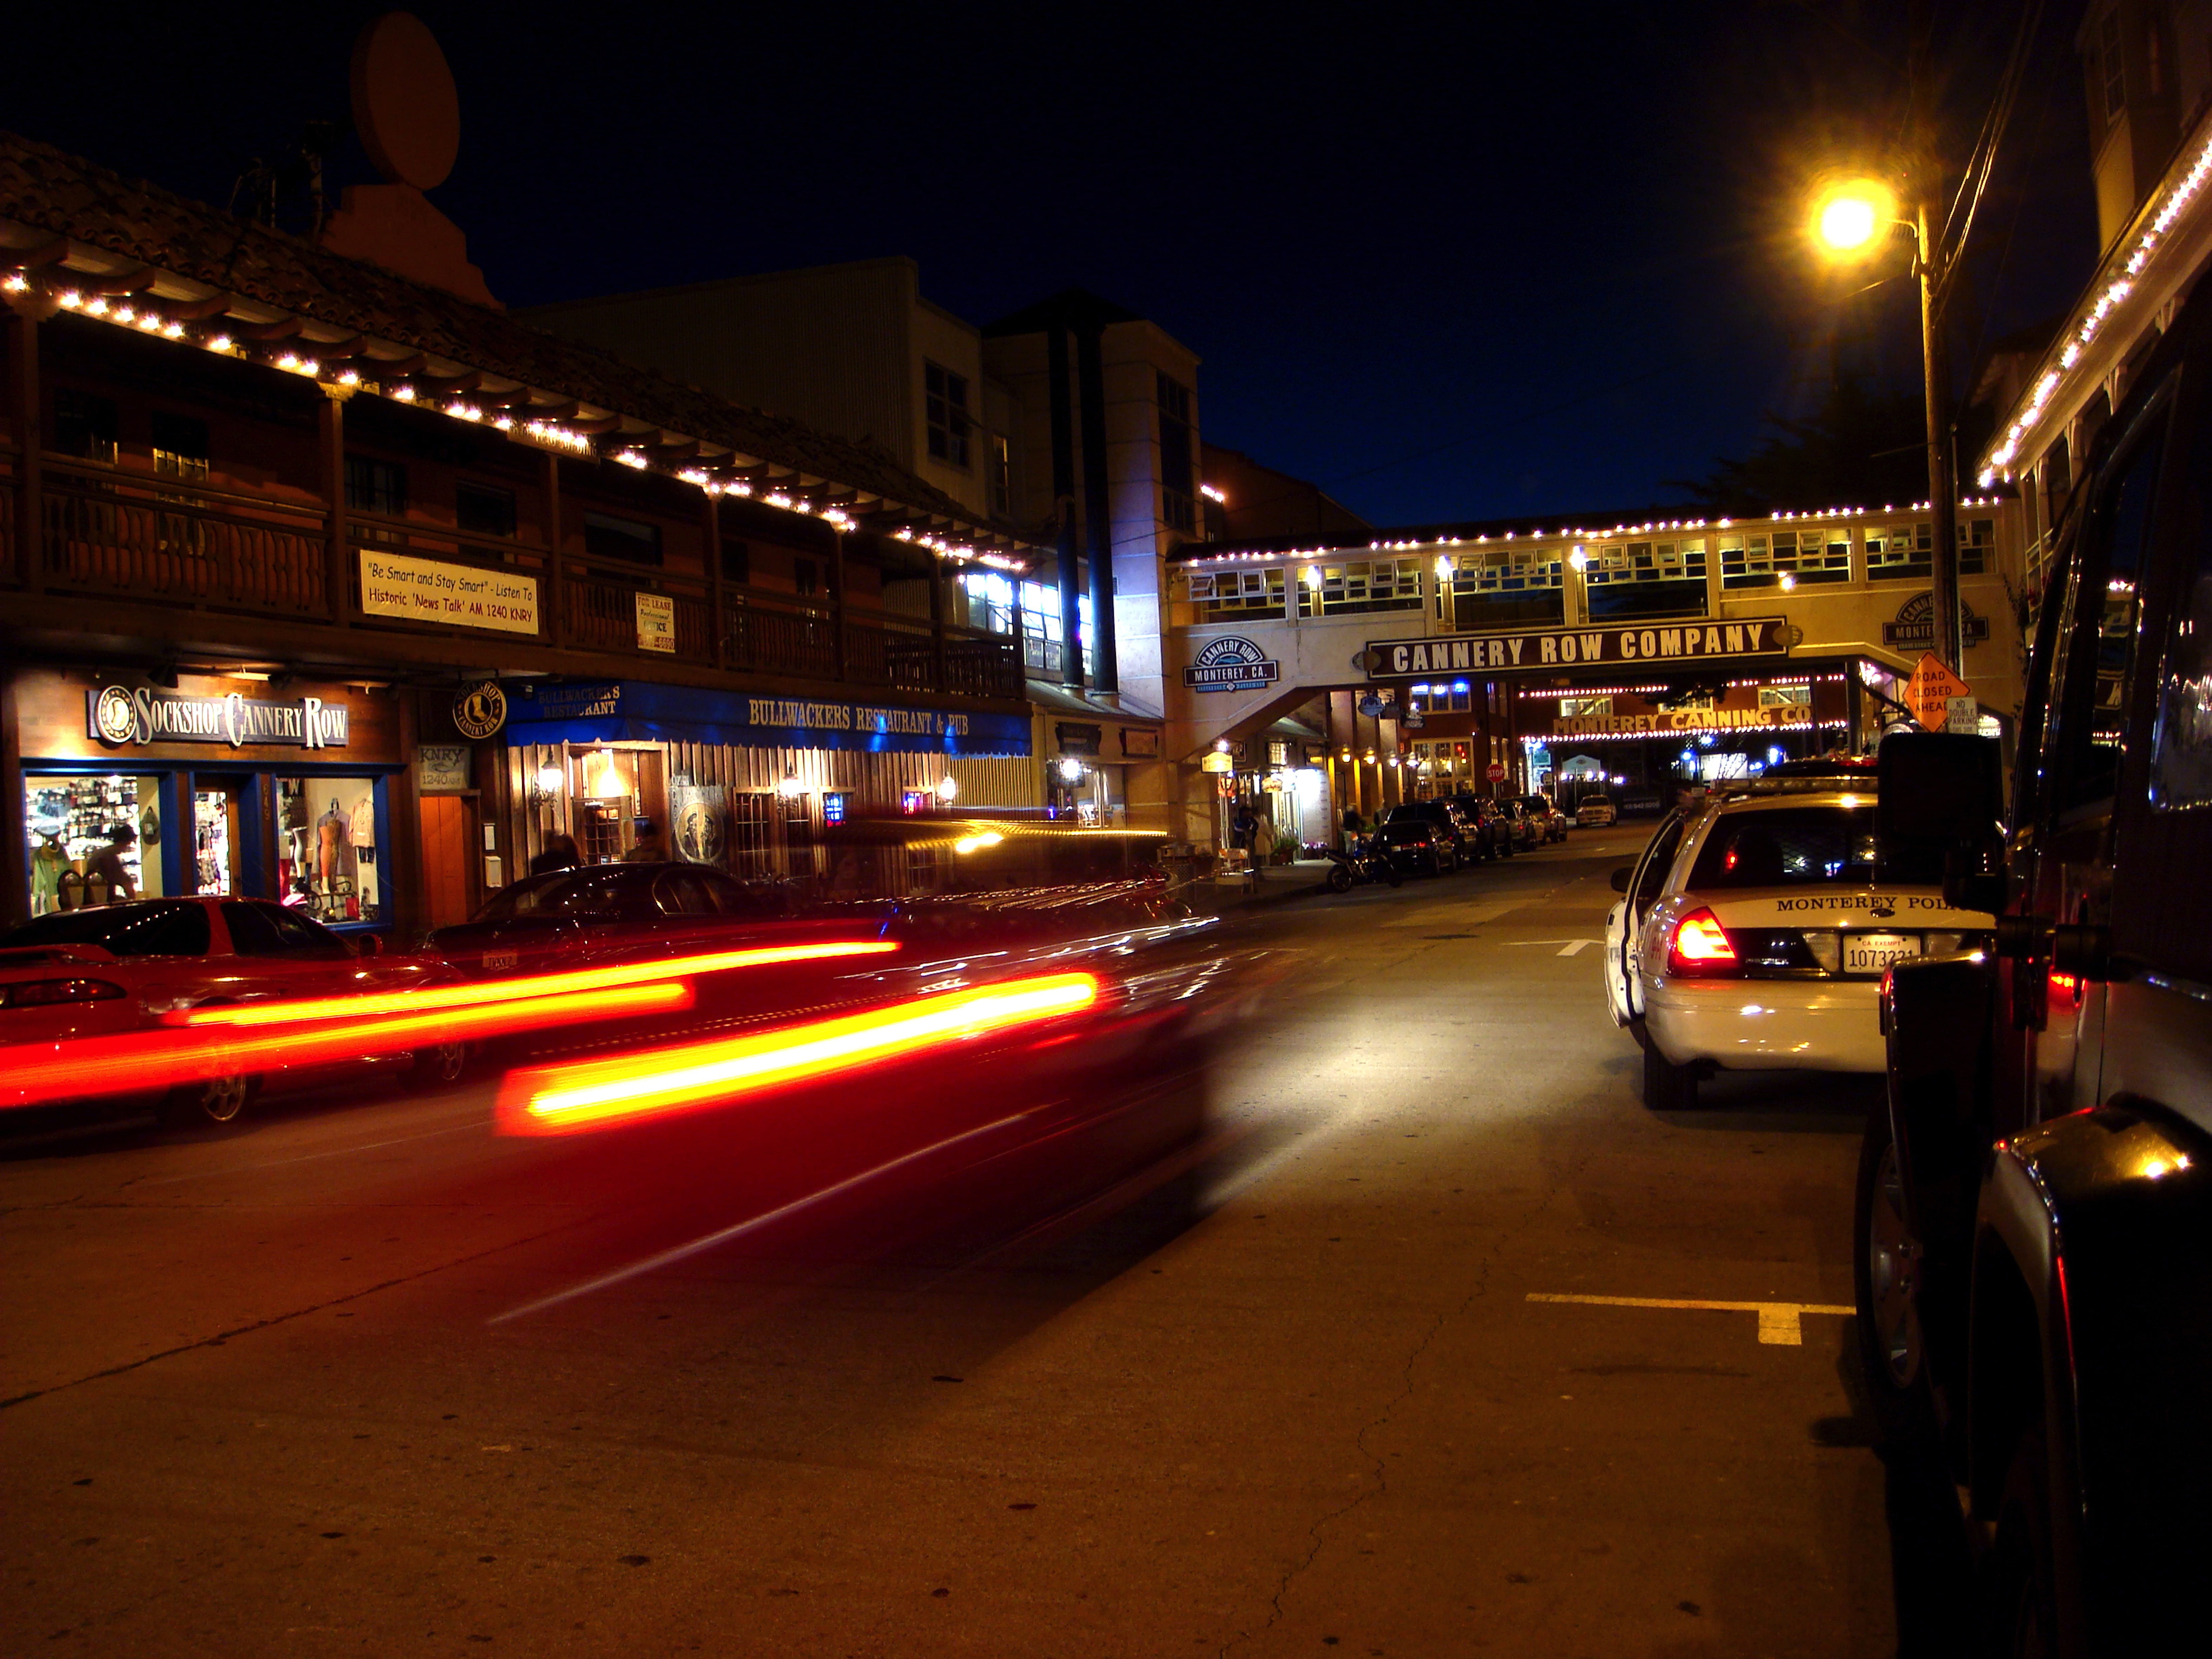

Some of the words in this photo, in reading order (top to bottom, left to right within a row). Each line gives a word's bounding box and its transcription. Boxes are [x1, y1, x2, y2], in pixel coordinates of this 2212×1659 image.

[387, 566, 415, 583] Smart
[417, 572, 433, 586] and
[435, 574, 455, 593] Stay
[496, 583, 520, 600] Listen
[523, 587, 532, 601] To
[369, 587, 407, 605] Historic
[412, 592, 439, 610] 'News
[443, 598, 465, 613] Talk'
[469, 602, 483, 615] AM
[487, 604, 507, 619] 1240
[510, 607, 532, 622] KNRY
[652, 599, 672, 611] LEASE
[1201, 640, 1240, 665] CANNERY
[1239, 644, 1258, 662] ROW
[1393, 638, 1523, 673] CANNERY
[1540, 633, 1602, 664] ROW
[1620, 623, 1763, 659] COMPANY
[1916, 671, 1945, 682] ROAD
[1913, 686, 1952, 698] CLOSED
[544, 700, 616, 718] RESTAURANT
[1956, 700, 1965, 708] NO
[134, 687, 223, 745] SOCKSHOP
[225, 692, 303, 747] CANNERY
[304, 697, 346, 748] ROW
[484, 716, 499, 733] ROW
[749, 698, 851, 730] BULLWACKERS
[856, 706, 932, 735] RESTAURANT
[936, 713, 944, 733] &
[948, 714, 969, 736] PUB
[1553, 714, 1659, 734] MONTEREY
[1670, 709, 1772, 729] CANNING
[1780, 706, 1811, 723] CO
[420, 748, 465, 766] KNRY
[1488, 769, 1504, 778] STOP
[1777, 896, 1897, 911] MONTEREY
